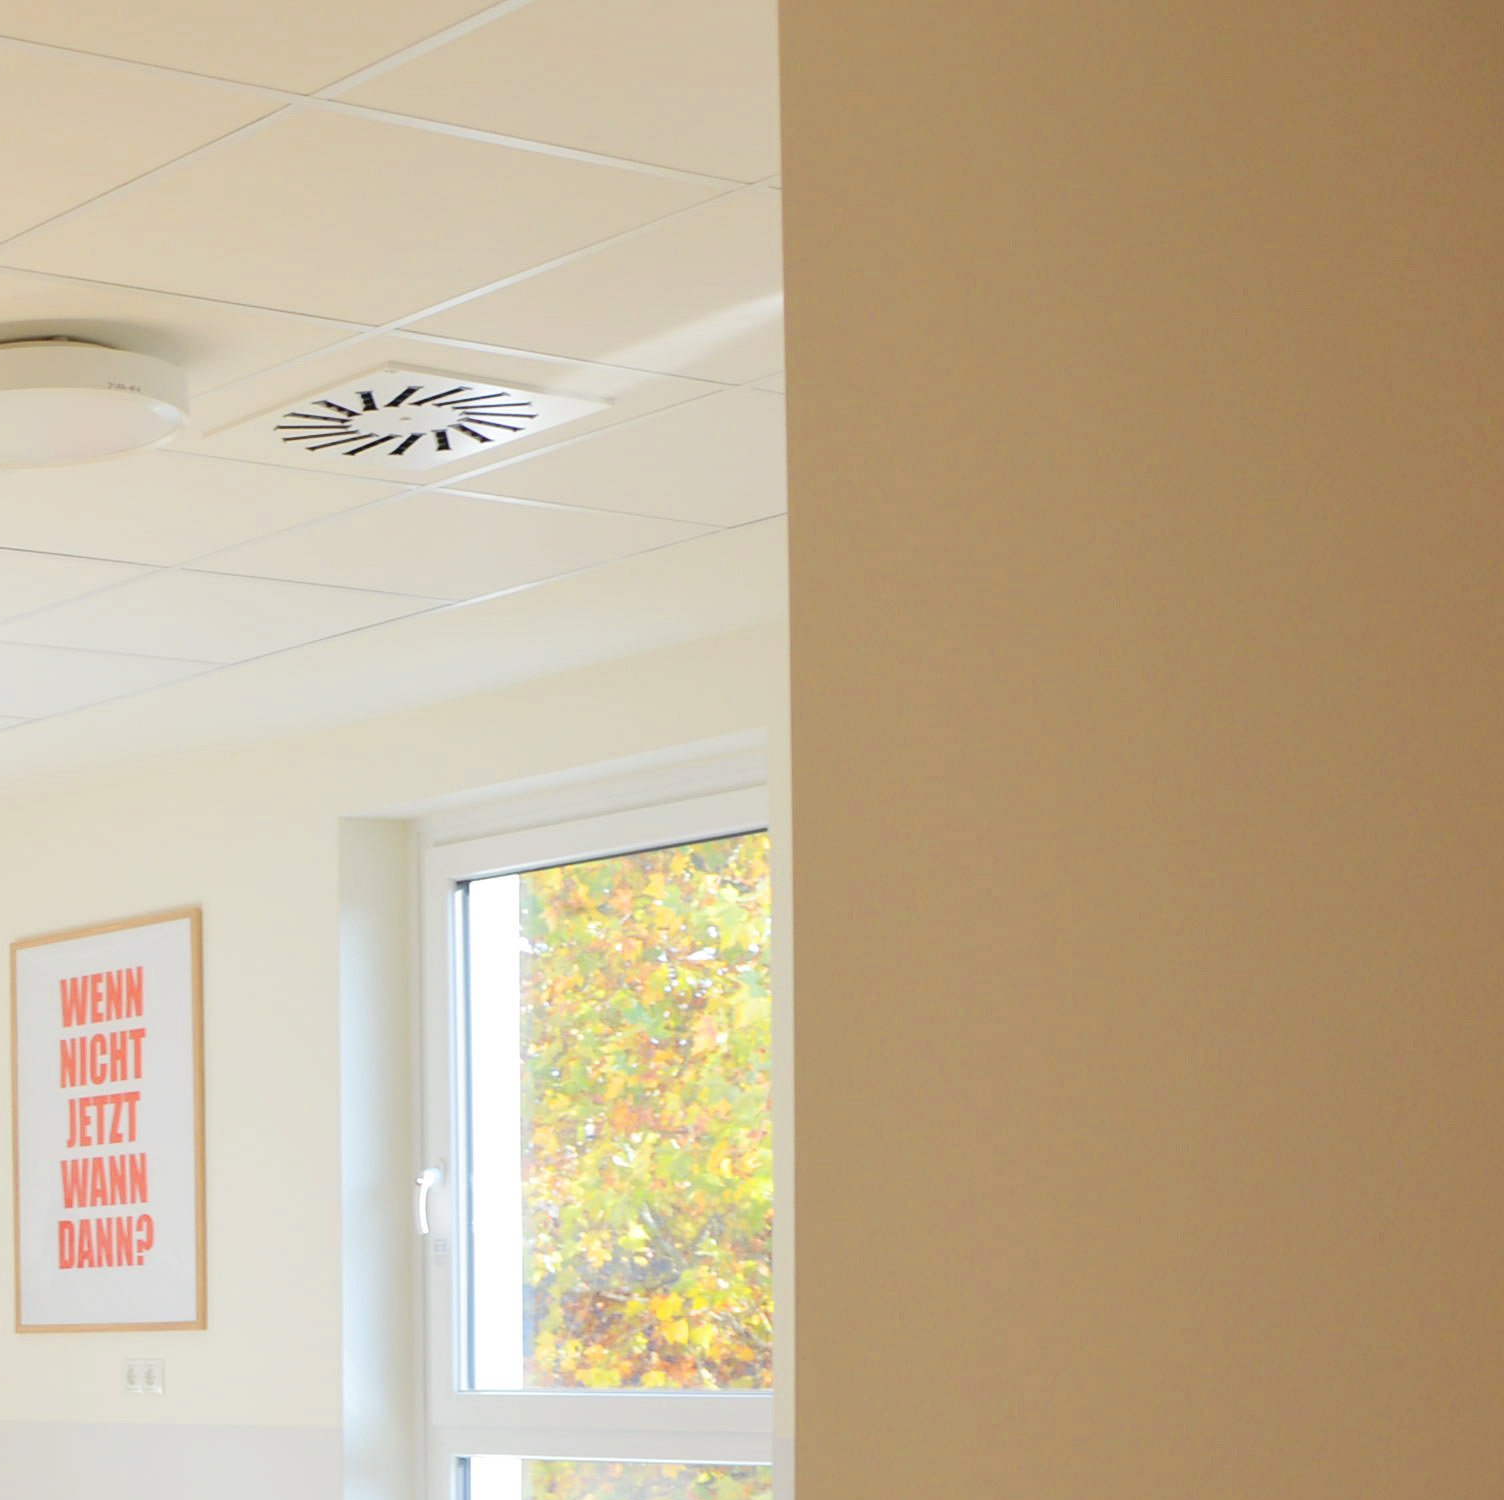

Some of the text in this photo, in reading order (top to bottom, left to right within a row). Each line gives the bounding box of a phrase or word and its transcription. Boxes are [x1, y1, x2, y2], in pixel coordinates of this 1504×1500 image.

[59, 966, 144, 1027] WENN
[60, 1029, 146, 1088] NICHT
[67, 1091, 141, 1148] JETZT
[61, 1153, 148, 1208] WANN
[58, 1214, 154, 1269] DANN?
